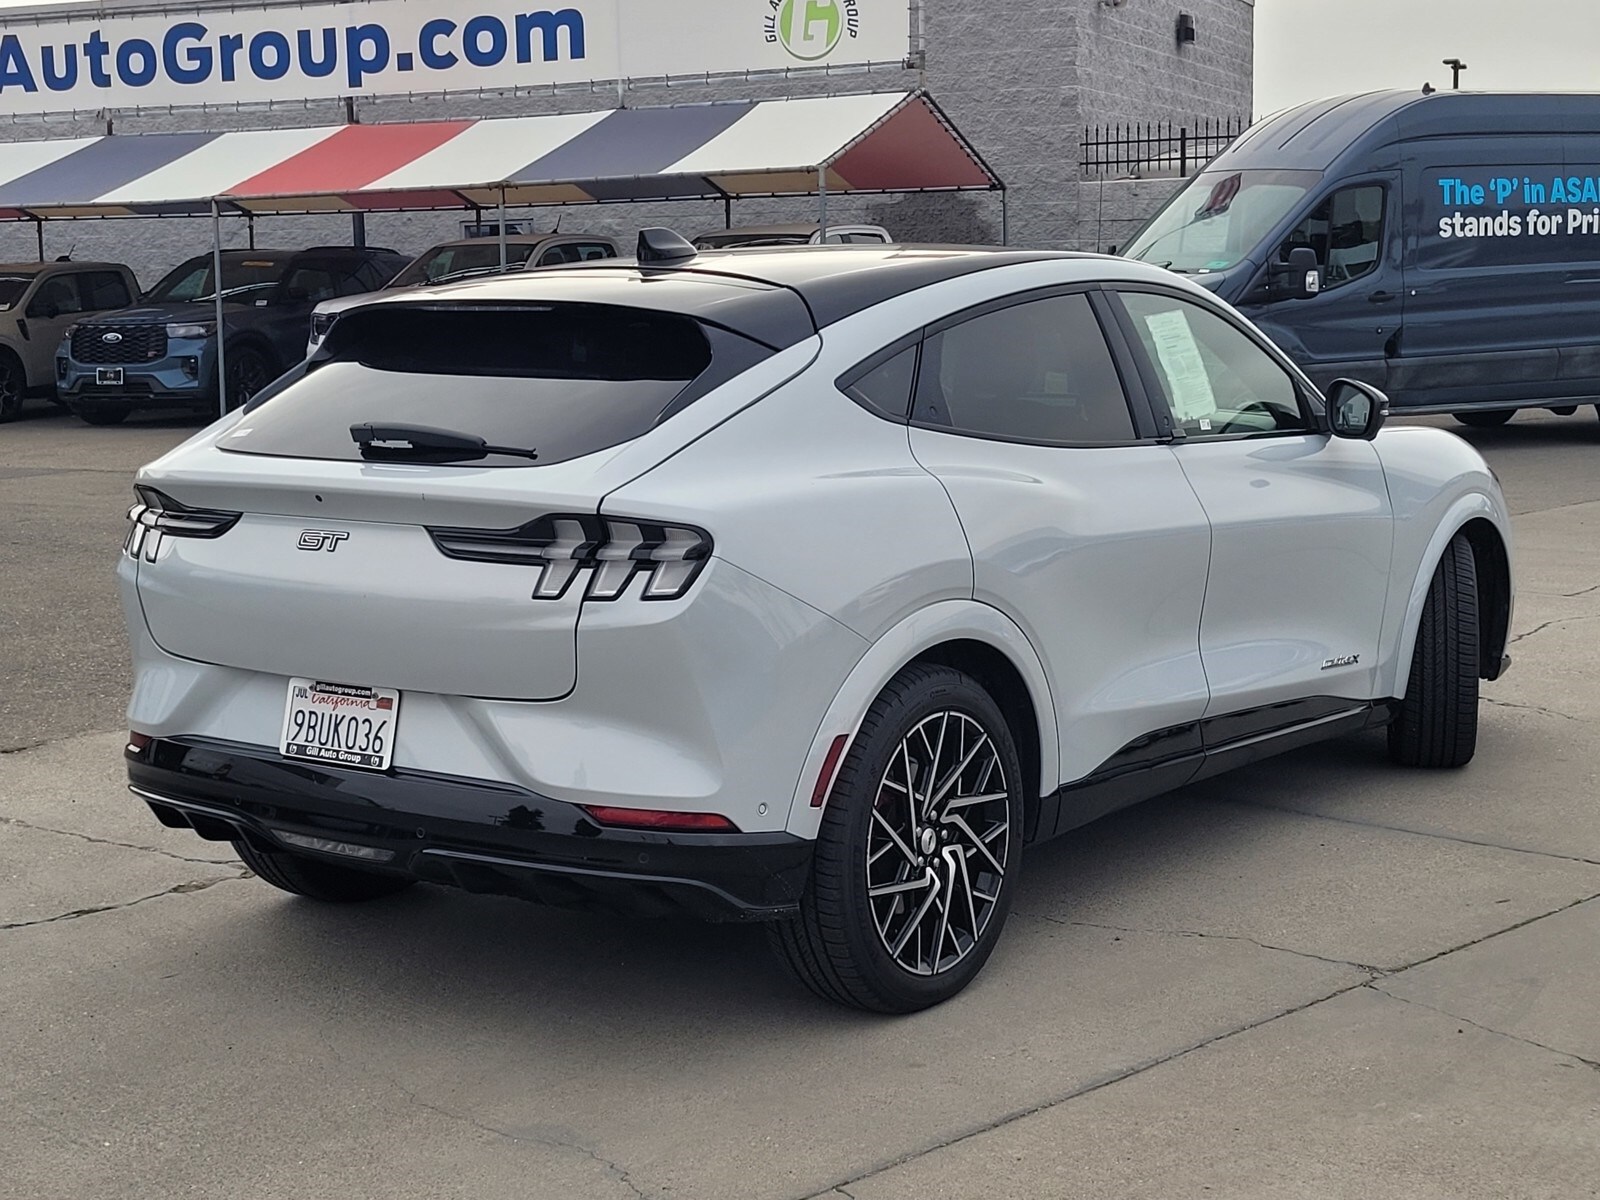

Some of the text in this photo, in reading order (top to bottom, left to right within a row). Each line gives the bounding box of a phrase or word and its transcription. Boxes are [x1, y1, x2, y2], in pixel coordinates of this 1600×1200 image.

[763, 14, 778, 43] GILL
[0, 8, 586, 93] AutoGroup.com
[1438, 178, 1485, 205] The
[1523, 177, 1545, 204] in
[1550, 176, 1600, 204] ASA
[1438, 210, 1522, 238] stands
[1526, 208, 1562, 236] for
[297, 528, 350, 552] GT
[295, 687, 309, 699] JUL
[311, 692, 374, 711] California
[291, 709, 388, 754] 9BUK036
[306, 746, 319, 756] Gill
[320, 749, 337, 759] Auto
[338, 751, 361, 764] Group
